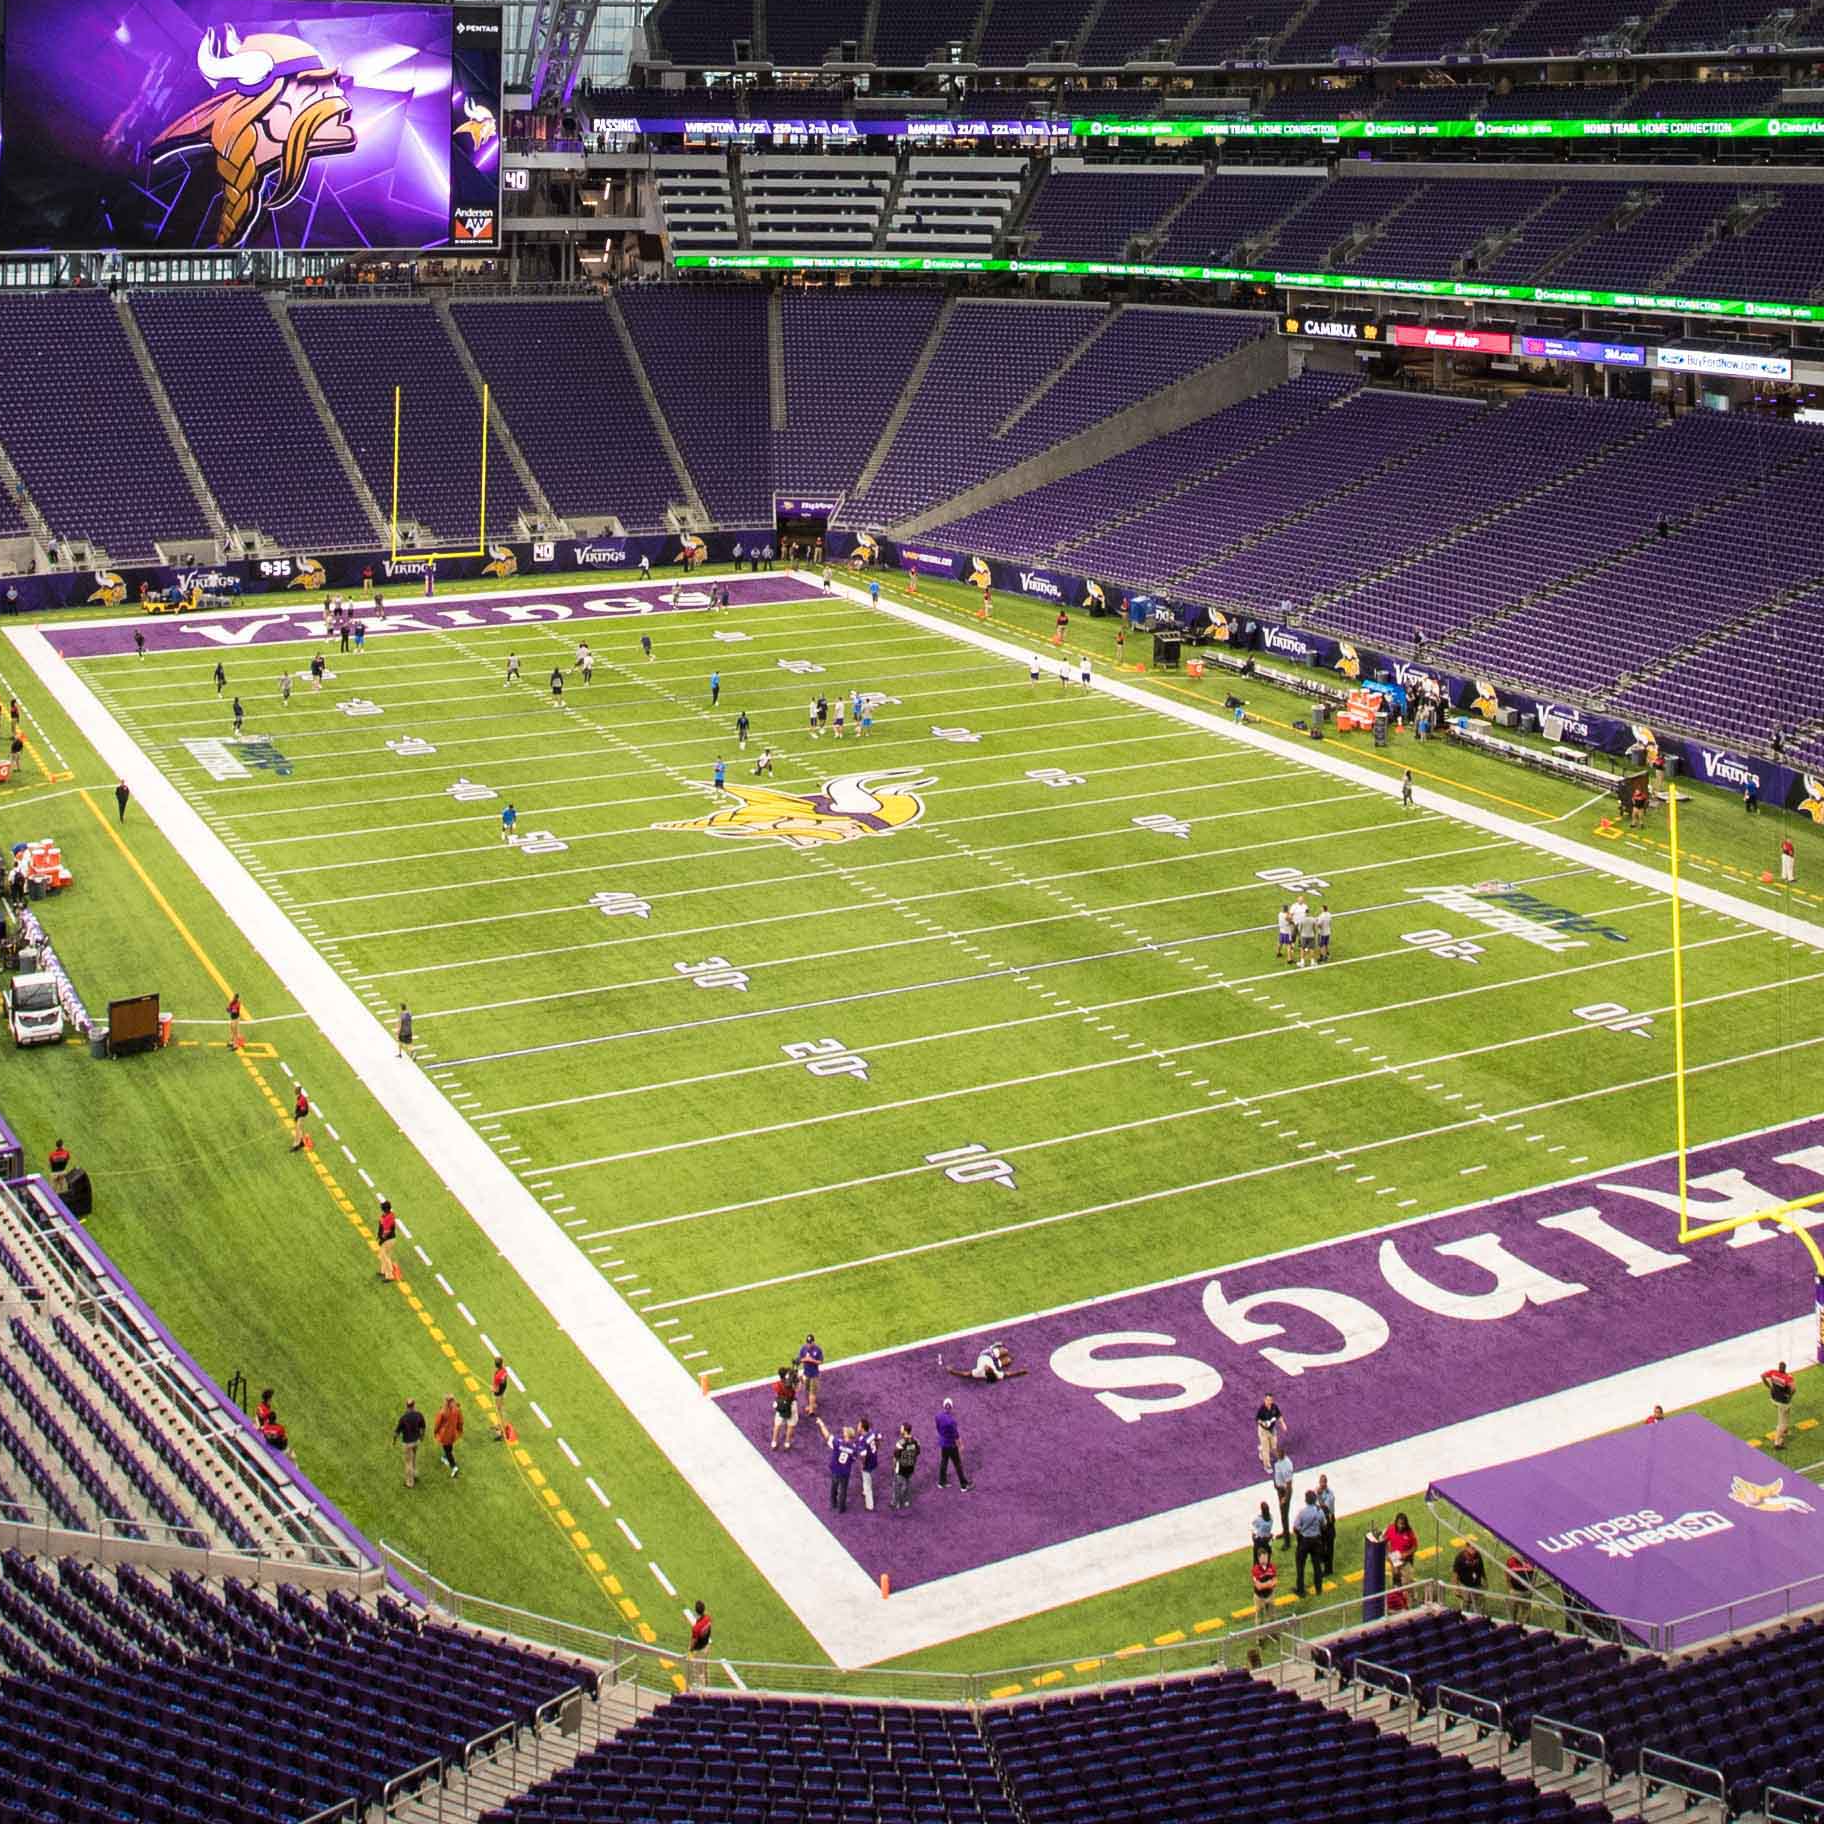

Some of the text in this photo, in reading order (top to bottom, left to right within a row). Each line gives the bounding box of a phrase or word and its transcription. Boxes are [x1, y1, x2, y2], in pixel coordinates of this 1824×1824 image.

[465, 24, 498, 33] PENTAIR
[593, 119, 635, 133] PASSING
[684, 122, 733, 133] WINSTON
[505, 171, 527, 189] 40
[455, 207, 493, 217] Andersen
[1304, 321, 1358, 338] CAMBRIA
[535, 543, 555, 559] 40
[260, 560, 292, 577] 9:35
[1255, 867, 1331, 892] 30
[1400, 929, 1488, 960] 20
[673, 956, 752, 989] 30
[1572, 1003, 1656, 1032] 10
[778, 1037, 871, 1077] 20
[924, 1143, 1016, 1185] 10
[1536, 1509, 1665, 1554] stadium
